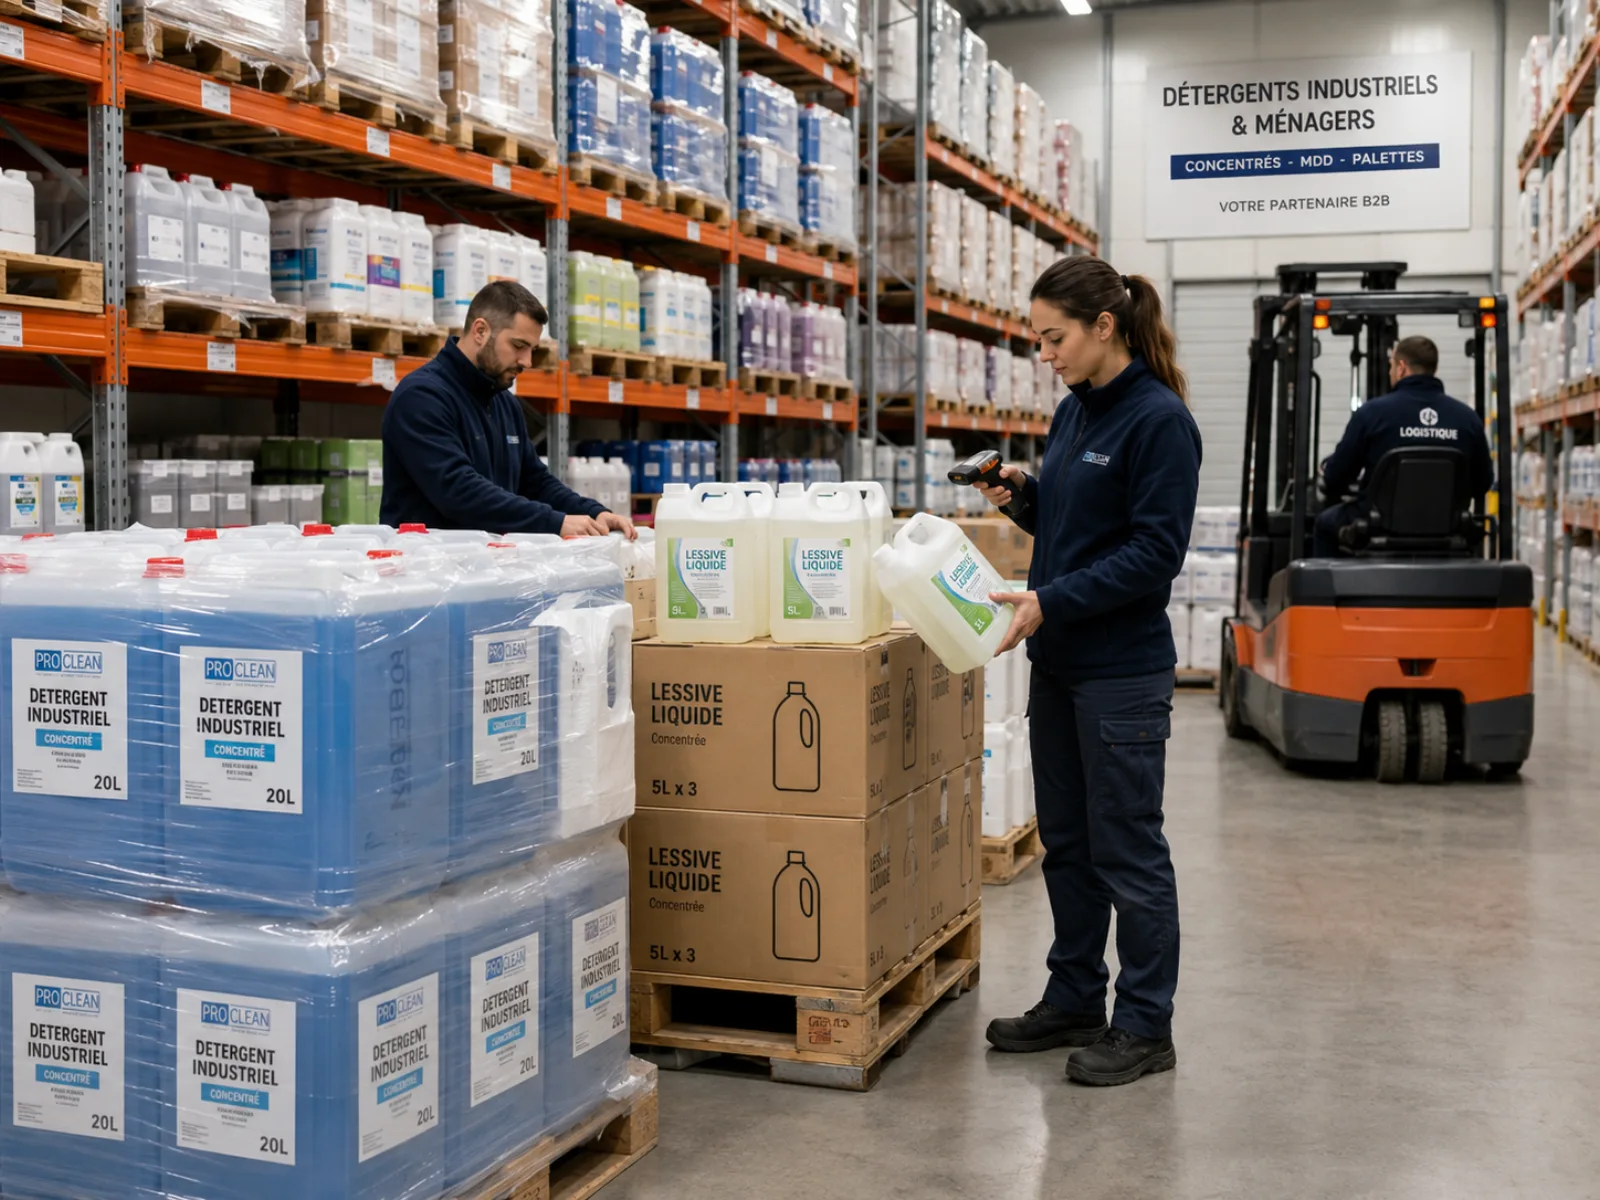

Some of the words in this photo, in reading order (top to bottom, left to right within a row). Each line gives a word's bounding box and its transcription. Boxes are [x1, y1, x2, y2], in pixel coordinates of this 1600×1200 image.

[1162, 80, 1300, 107] DÉTERGENTS
[1307, 74, 1439, 99] INDUSTRIELS
[1231, 115, 1247, 136] &
[1255, 108, 1376, 135] MÉNAGERS
[1185, 154, 1282, 173] CONCENTRÉS
[1300, 154, 1334, 169] MDD
[1352, 150, 1425, 166] PALETTES
[1219, 199, 1265, 213] VOTRE
[1269, 196, 1358, 211] PARTENAIRE
[1362, 194, 1390, 208] B2B
[1399, 426, 1459, 440] LOGISTIQUE
[685, 549, 727, 560] LESSIVE
[801, 549, 844, 560] LESSIVE
[685, 560, 727, 572] LIQUIDE
[802, 560, 844, 572] LIQUIDE
[485, 673, 530, 695] DETERGENT
[651, 681, 724, 703] LESSIVE
[29, 687, 108, 707] DETERGENT
[199, 696, 282, 718] DETERGENT
[483, 691, 532, 714] INDUSTRIEL
[27, 706, 111, 727] INDUSTRIEL
[651, 704, 724, 727] LIQUIDE
[196, 716, 285, 738] INDUSTRIEL
[44, 732, 94, 747] CONCENTRÉ
[651, 732, 707, 748] Concentrée
[213, 744, 266, 758] CONCENTRÉ
[521, 750, 536, 766] 20L
[93, 774, 122, 791] 20L
[652, 779, 670, 795] 5L
[675, 783, 684, 796] x
[688, 781, 697, 797] 3
[266, 787, 296, 805] 20L
[648, 846, 722, 871] LESSIVE
[648, 870, 722, 894] LIQUIDE
[649, 897, 705, 913] Concentrée
[650, 945, 669, 962] 5L
[673, 949, 682, 962] x
[686, 947, 696, 964] 3
[482, 979, 530, 1014] DETERGENT
[481, 998, 532, 1033] INDUSTRIEL
[29, 1022, 106, 1047] DETERGENT
[373, 1024, 428, 1062] DETERGENT
[27, 1041, 109, 1067] INDUSTRIEL
[195, 1039, 276, 1066] DETERGENT
[371, 1043, 430, 1083] INDUSTRIEL
[192, 1058, 279, 1087] INDUSTRIEL
[520, 1055, 537, 1076] 20L
[44, 1069, 91, 1086] CONCENTRÉ
[210, 1087, 261, 1106] CONCENTRÉ
[91, 1113, 119, 1133] 20L
[416, 1105, 435, 1127] 20L
[260, 1136, 289, 1156] 20L
